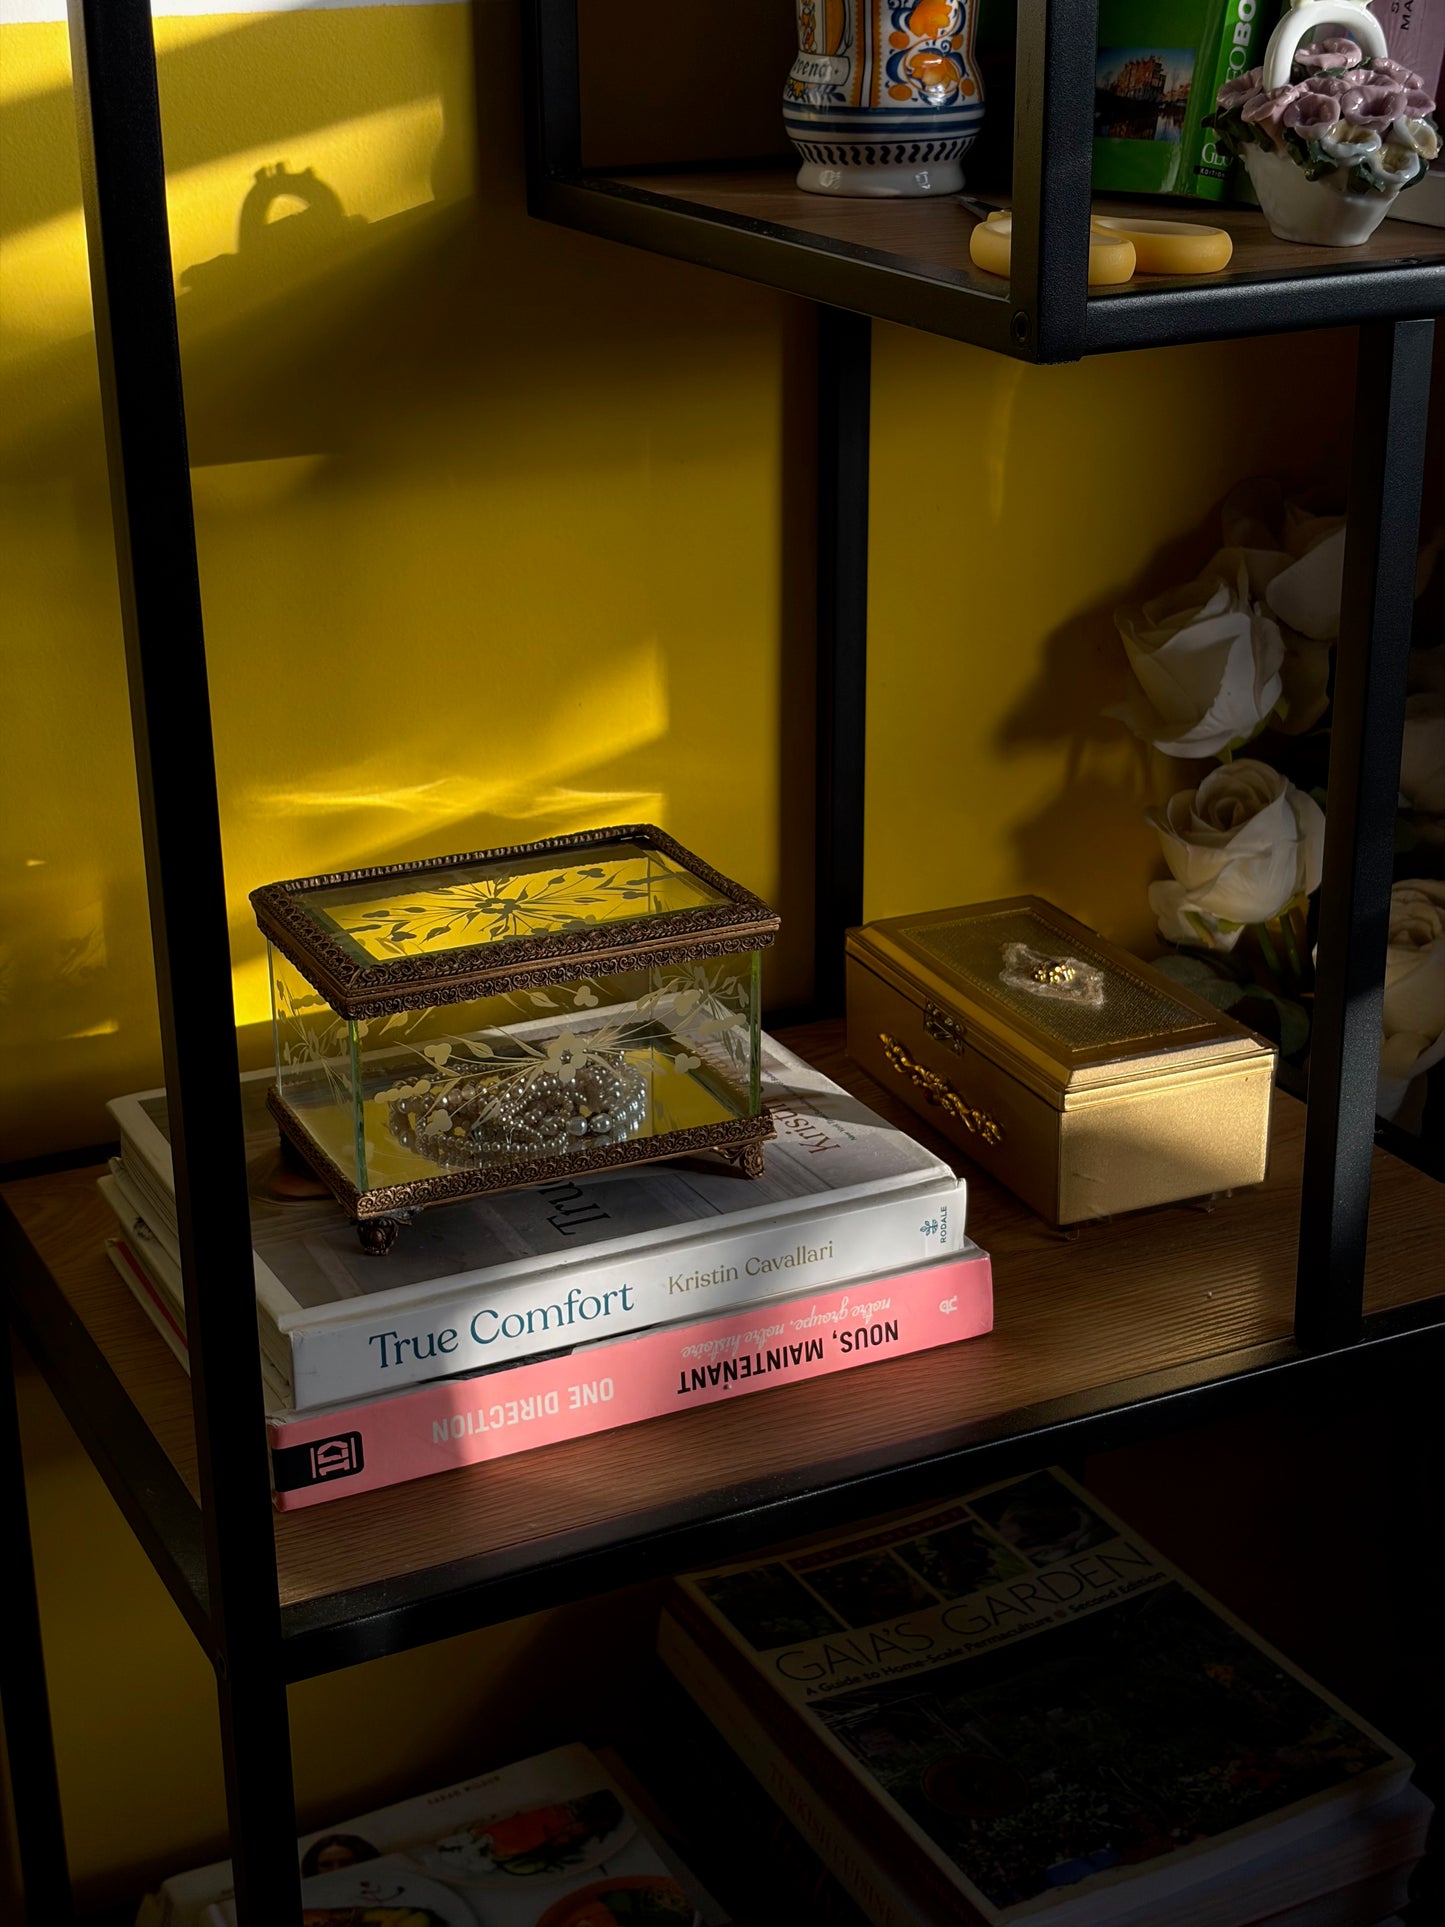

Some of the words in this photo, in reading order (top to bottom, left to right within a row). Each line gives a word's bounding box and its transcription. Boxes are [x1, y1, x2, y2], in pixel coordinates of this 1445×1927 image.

[939, 1206, 947, 1243] RODALE
[668, 1265, 739, 1295] Kristin
[745, 1241, 834, 1276] Cavallari
[368, 1328, 459, 1369] True
[470, 1283, 635, 1345] Comfort
[852, 1297, 891, 1325] notre
[682, 1329, 744, 1358] histoire
[743, 1322, 785, 1352] notre
[832, 1319, 899, 1353] NOUS,
[677, 1337, 823, 1394] MAINTENANT
[568, 1378, 615, 1409] ONE
[432, 1394, 559, 1444] DIRECTION
[776, 1621, 935, 1681] GAIA'S
[942, 1542, 1152, 1635] GARDEN
[818, 1675, 860, 1692] Guide
[863, 1669, 881, 1680] to
[963, 1616, 1054, 1651] Permaculture
[1069, 1588, 1118, 1613] Second
[1118, 1571, 1167, 1595] Edition
